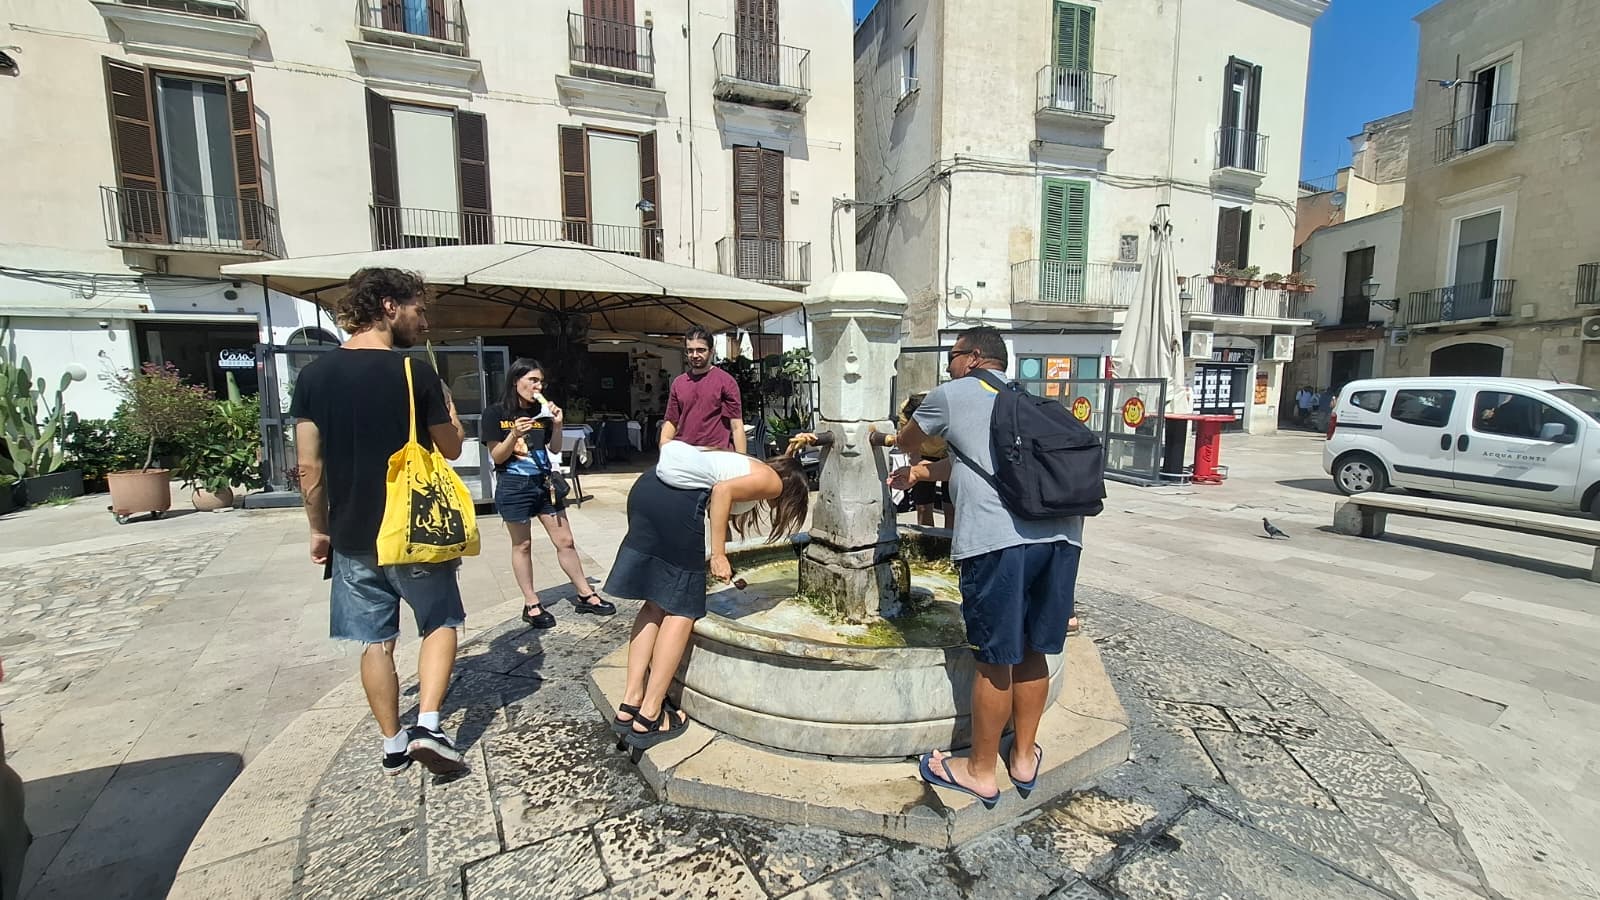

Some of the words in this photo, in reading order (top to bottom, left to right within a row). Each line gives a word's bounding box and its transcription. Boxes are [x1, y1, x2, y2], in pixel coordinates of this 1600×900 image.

[220, 349, 255, 361] Casa
[1482, 451, 1512, 459] ACQUA
[1517, 454, 1547, 462] FONTE
